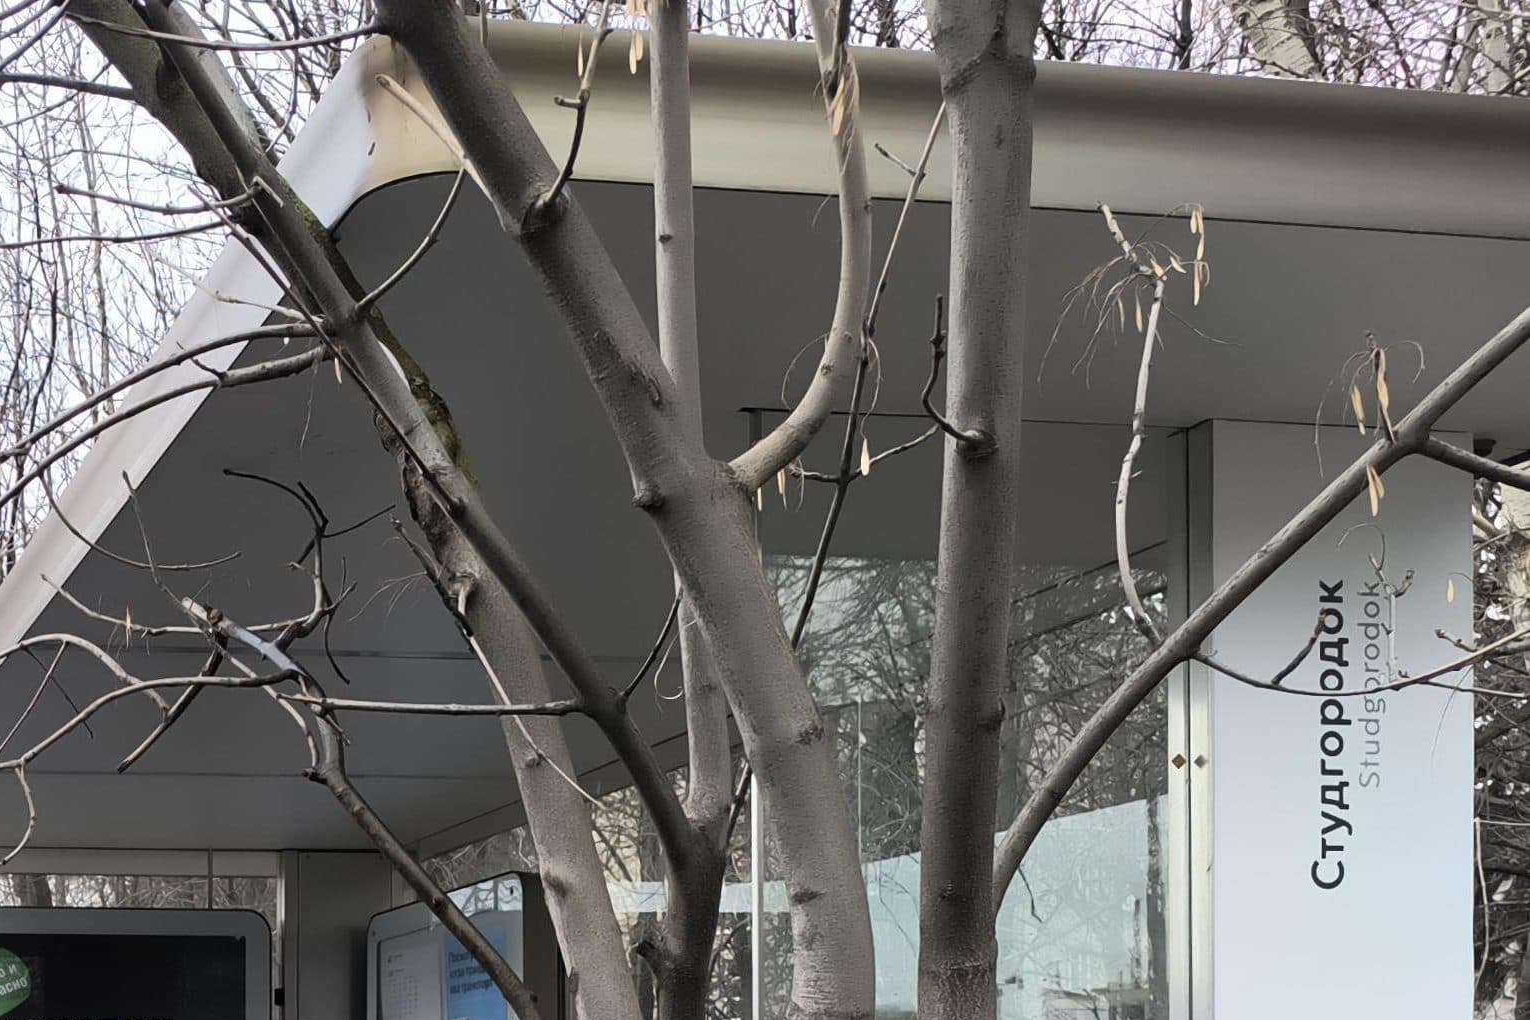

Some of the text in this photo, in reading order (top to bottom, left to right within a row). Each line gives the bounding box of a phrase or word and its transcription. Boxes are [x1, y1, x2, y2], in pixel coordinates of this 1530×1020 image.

[1311, 579, 1353, 890] Студгородок
[1357, 581, 1386, 789] Studgorodok
[8, 963, 18, 975] и
